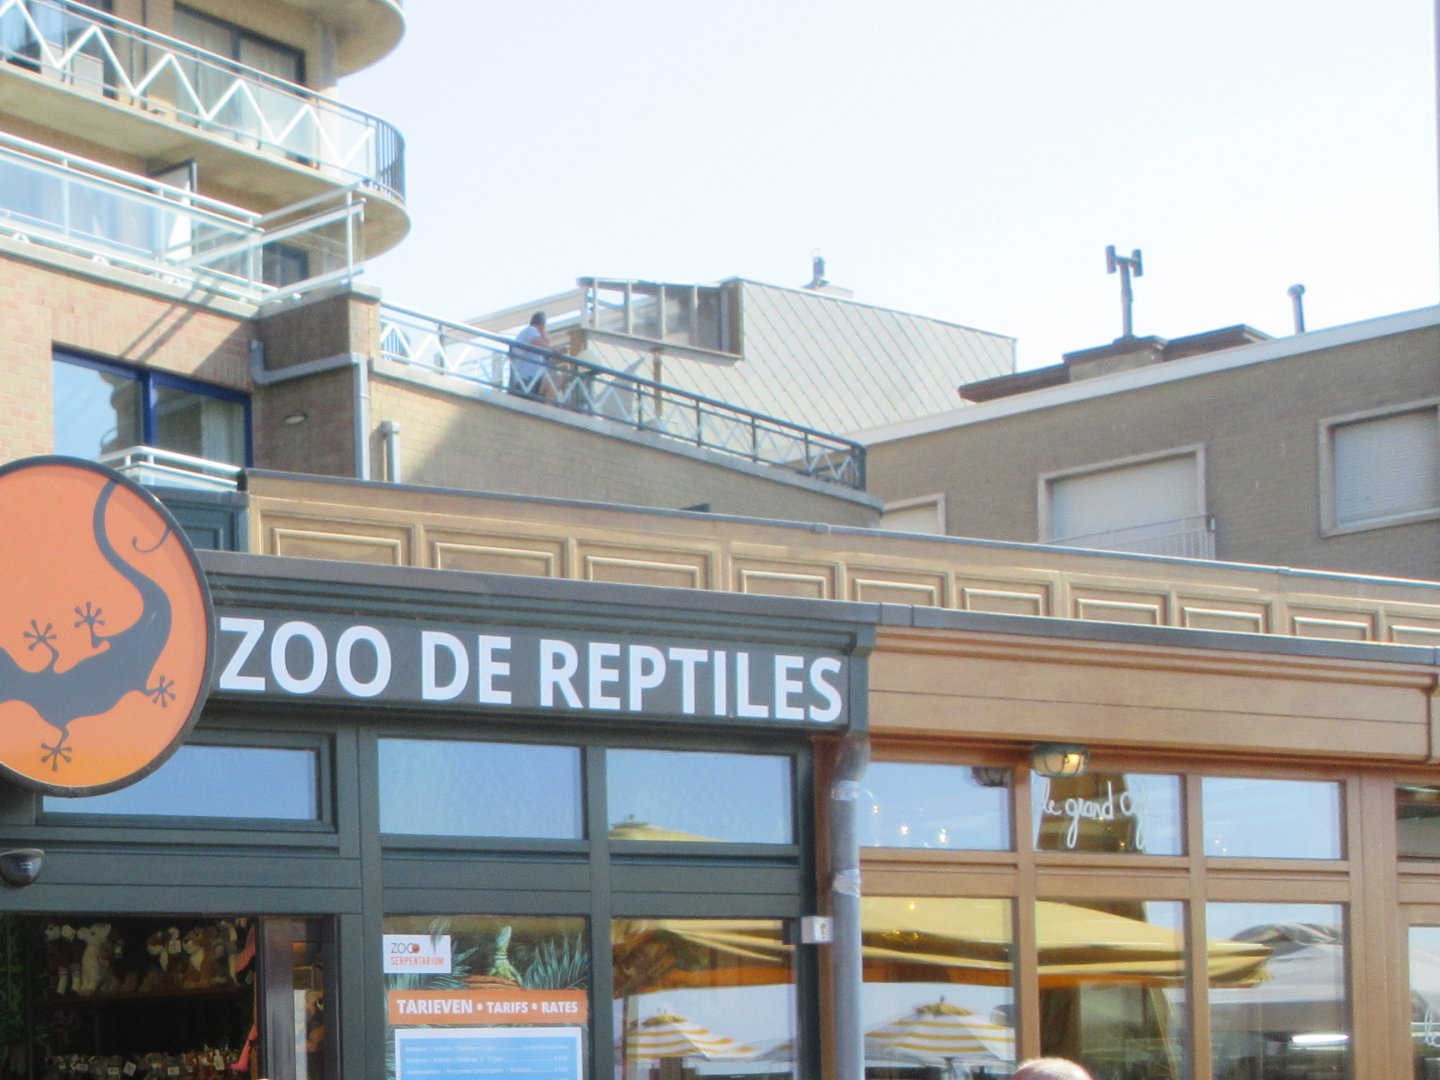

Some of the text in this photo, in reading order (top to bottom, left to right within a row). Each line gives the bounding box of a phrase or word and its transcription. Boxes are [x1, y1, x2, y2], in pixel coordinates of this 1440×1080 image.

[219, 617, 843, 722] ZOO DE REPTILES
[1044, 778, 1062, 815] le
[1065, 781, 1114, 848] grand
[391, 957, 444, 966] SERPENTARIUM
[397, 999, 578, 1014] TARIEVEN TARIFS RATES
